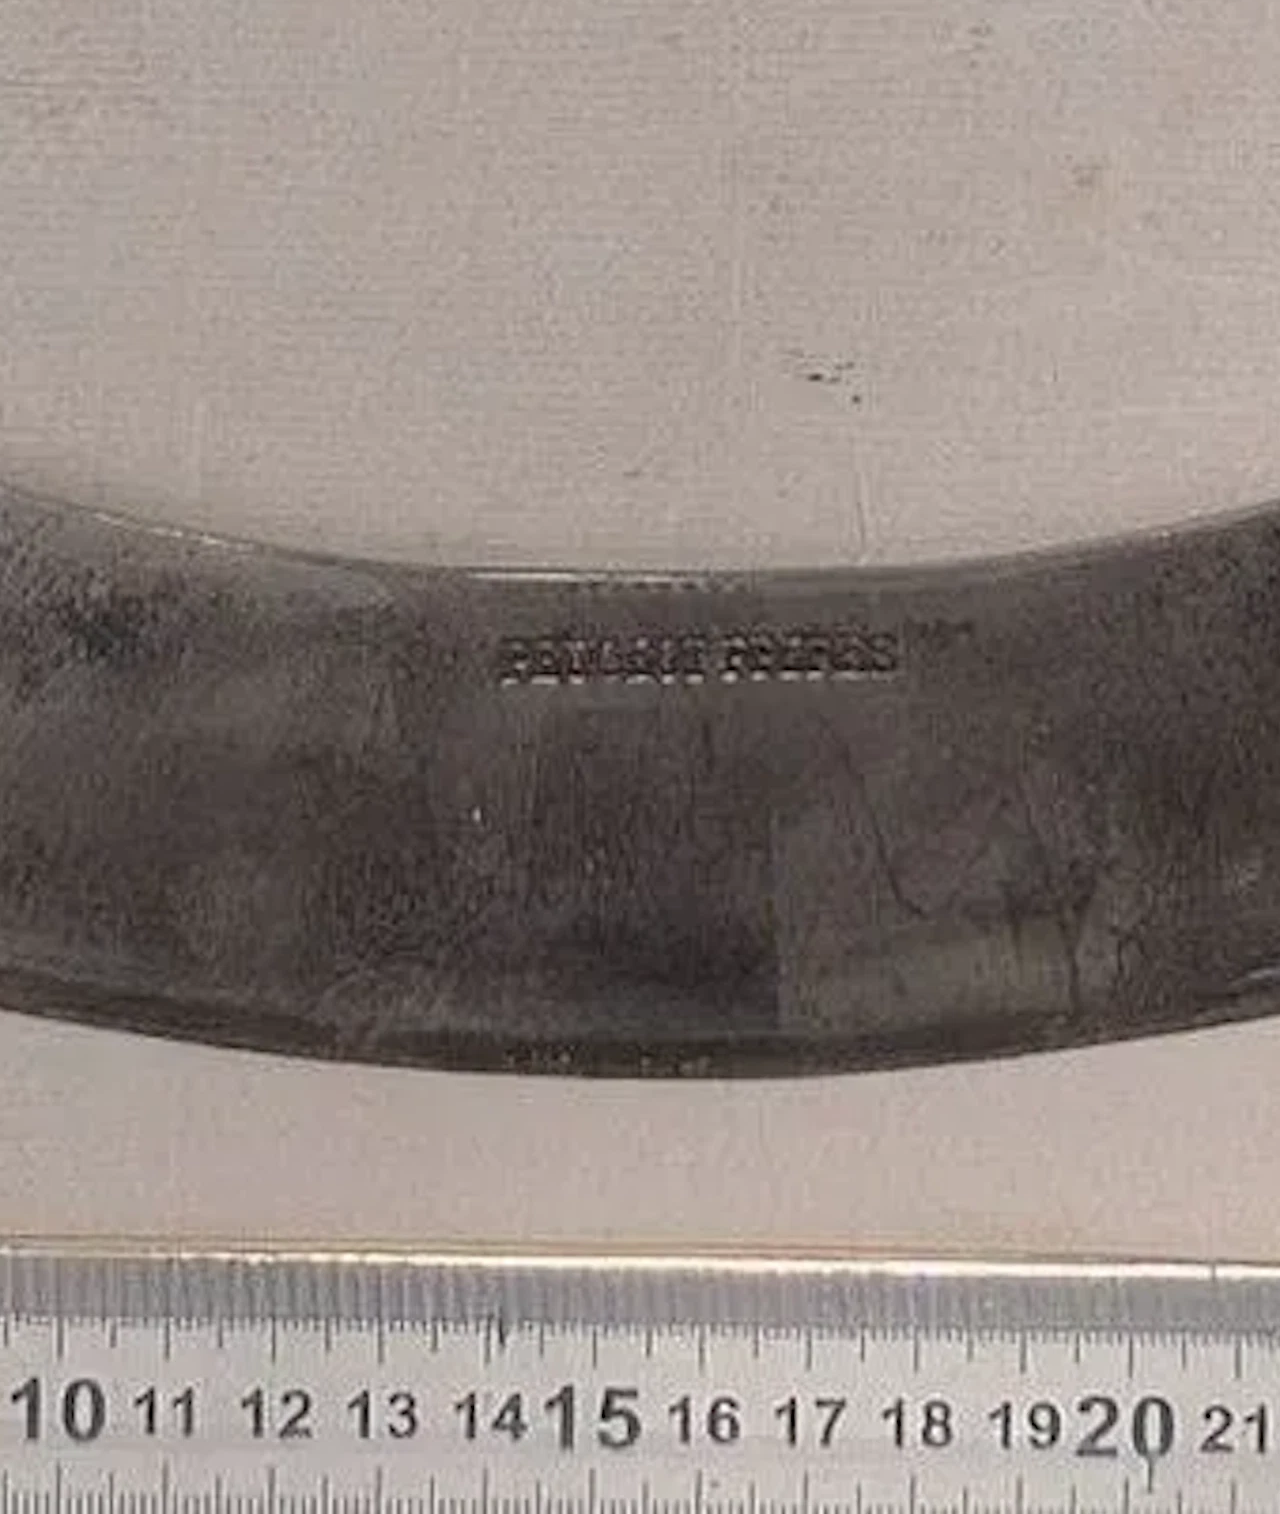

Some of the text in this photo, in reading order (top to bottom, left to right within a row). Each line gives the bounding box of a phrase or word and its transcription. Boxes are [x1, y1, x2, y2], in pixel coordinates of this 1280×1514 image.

[10, 1375, 106, 1445] 10
[133, 1385, 195, 1440] 11
[240, 1386, 313, 1441] 12
[347, 1389, 419, 1440] 13
[454, 1390, 528, 1444] 14
[543, 1383, 642, 1453] 15
[668, 1394, 741, 1447] 16
[774, 1395, 848, 1450] 17
[880, 1396, 954, 1452] 18
[987, 1400, 1062, 1452] 19
[1074, 1394, 1176, 1462] 20
[1199, 1402, 1268, 1457] 21
